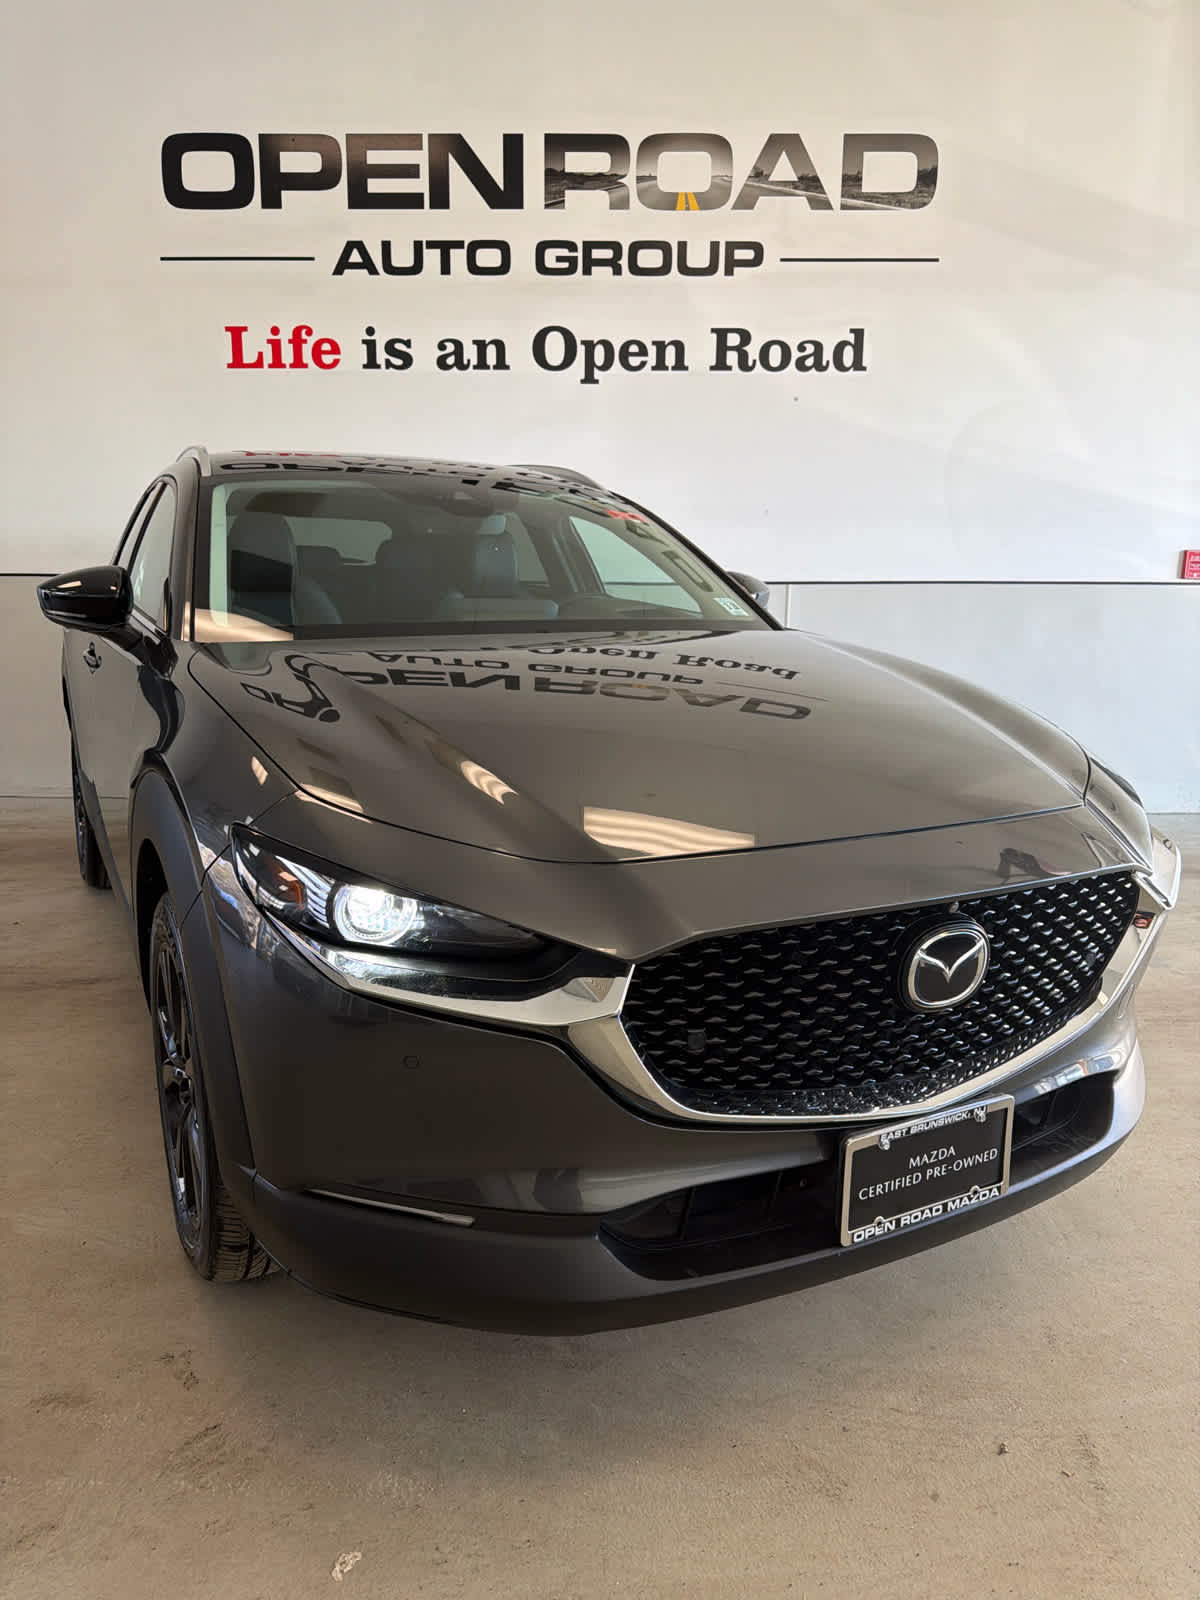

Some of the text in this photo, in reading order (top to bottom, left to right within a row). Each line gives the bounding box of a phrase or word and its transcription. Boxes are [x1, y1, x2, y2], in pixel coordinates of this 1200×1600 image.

[160, 132, 940, 212] OPEN ROAD
[331, 240, 765, 277] AUTO GROUP
[225, 325, 868, 385] Life is an Open Road
[858, 1148, 999, 1201] CERTIFIED PRE-OWNED
[908, 1145, 957, 1170] MAZDA
[853, 1186, 1000, 1243] OPEN ROAD MAZDA
